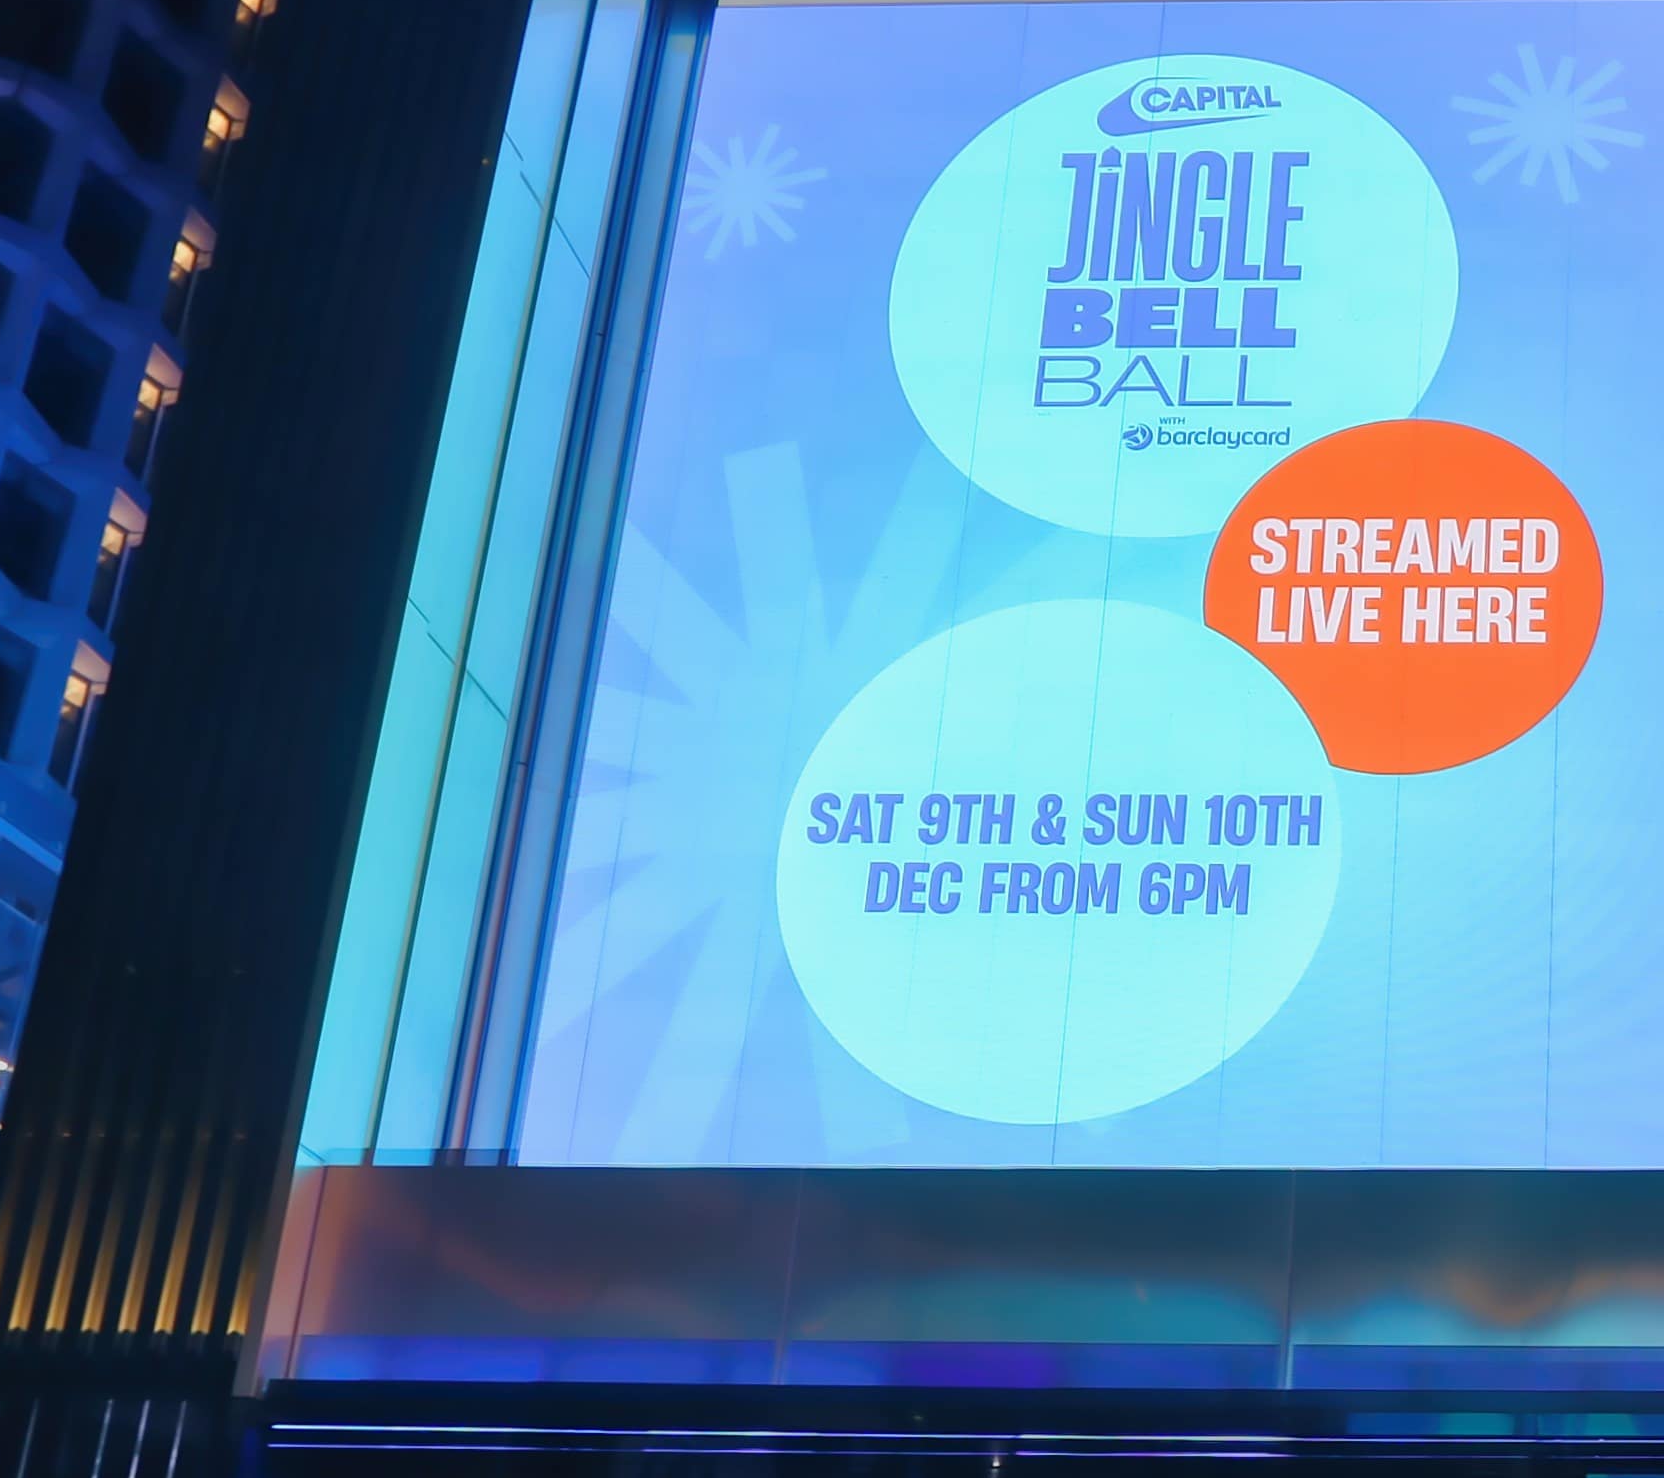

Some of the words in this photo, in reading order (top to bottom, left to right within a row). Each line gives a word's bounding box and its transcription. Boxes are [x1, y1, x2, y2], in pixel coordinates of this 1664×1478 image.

[1141, 85, 1282, 113] CAPITAL
[1040, 287, 1296, 348] BELL
[1034, 354, 1293, 407] BALL
[1157, 426, 1290, 449] barclaycard
[1159, 416, 1185, 425] WITH
[1250, 518, 1560, 575] STREAMED
[1256, 586, 1382, 643] LIVE
[1401, 586, 1547, 643] HERE
[806, 793, 904, 844] SAT
[918, 794, 1015, 845] 9TH
[1031, 794, 1066, 845] &
[1082, 794, 1188, 845] SUN
[1204, 795, 1322, 846] 10TH
[864, 862, 963, 914] DEC
[979, 862, 1121, 914] FROM
[1138, 863, 1251, 915] 6PM
